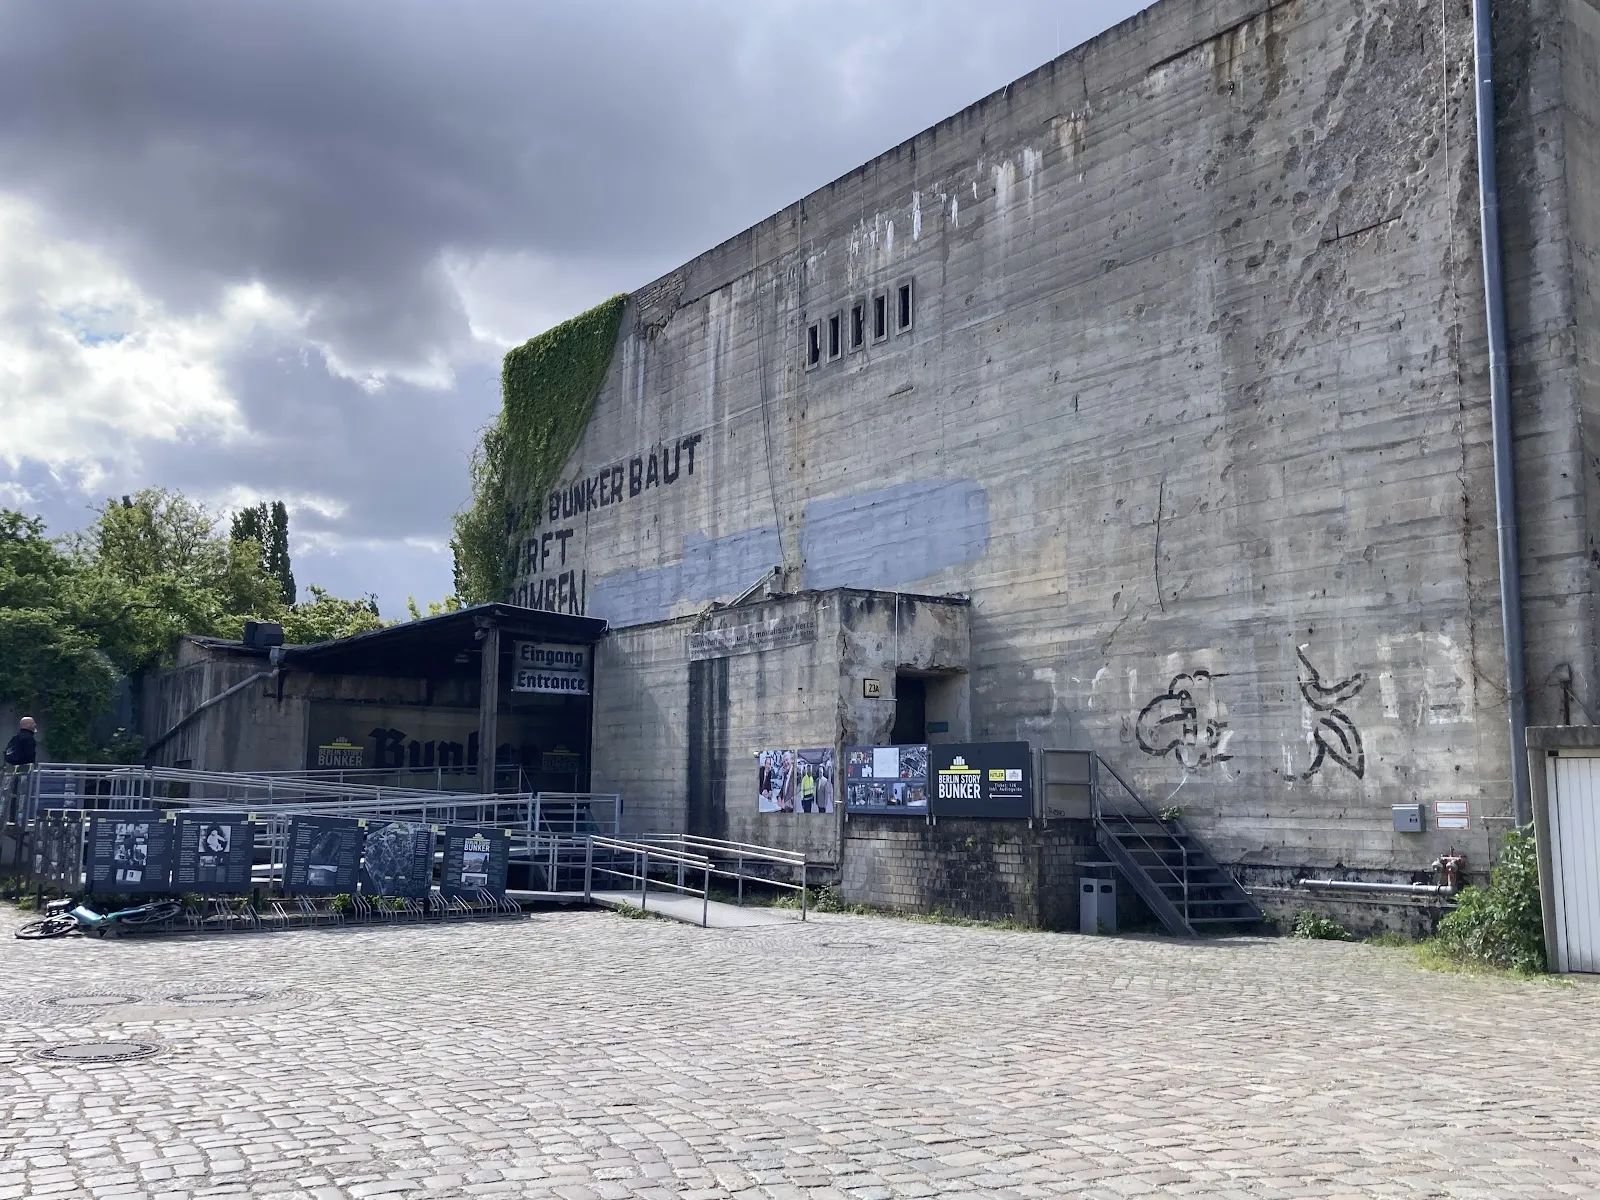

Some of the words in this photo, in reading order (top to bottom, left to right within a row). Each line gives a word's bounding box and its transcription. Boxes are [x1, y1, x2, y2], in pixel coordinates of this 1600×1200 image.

[549, 464, 624, 523] BUNKER
[630, 434, 701, 498] BAUT
[520, 644, 584, 668] Eingang
[517, 670, 586, 690] Entrance
[868, 683, 880, 693] 23A
[317, 755, 363, 767] BUNKER
[938, 774, 959, 784] BERLIN
[960, 774, 981, 784] STORY
[938, 783, 981, 799] BUNKER
[464, 843, 490, 852] BUNKER
